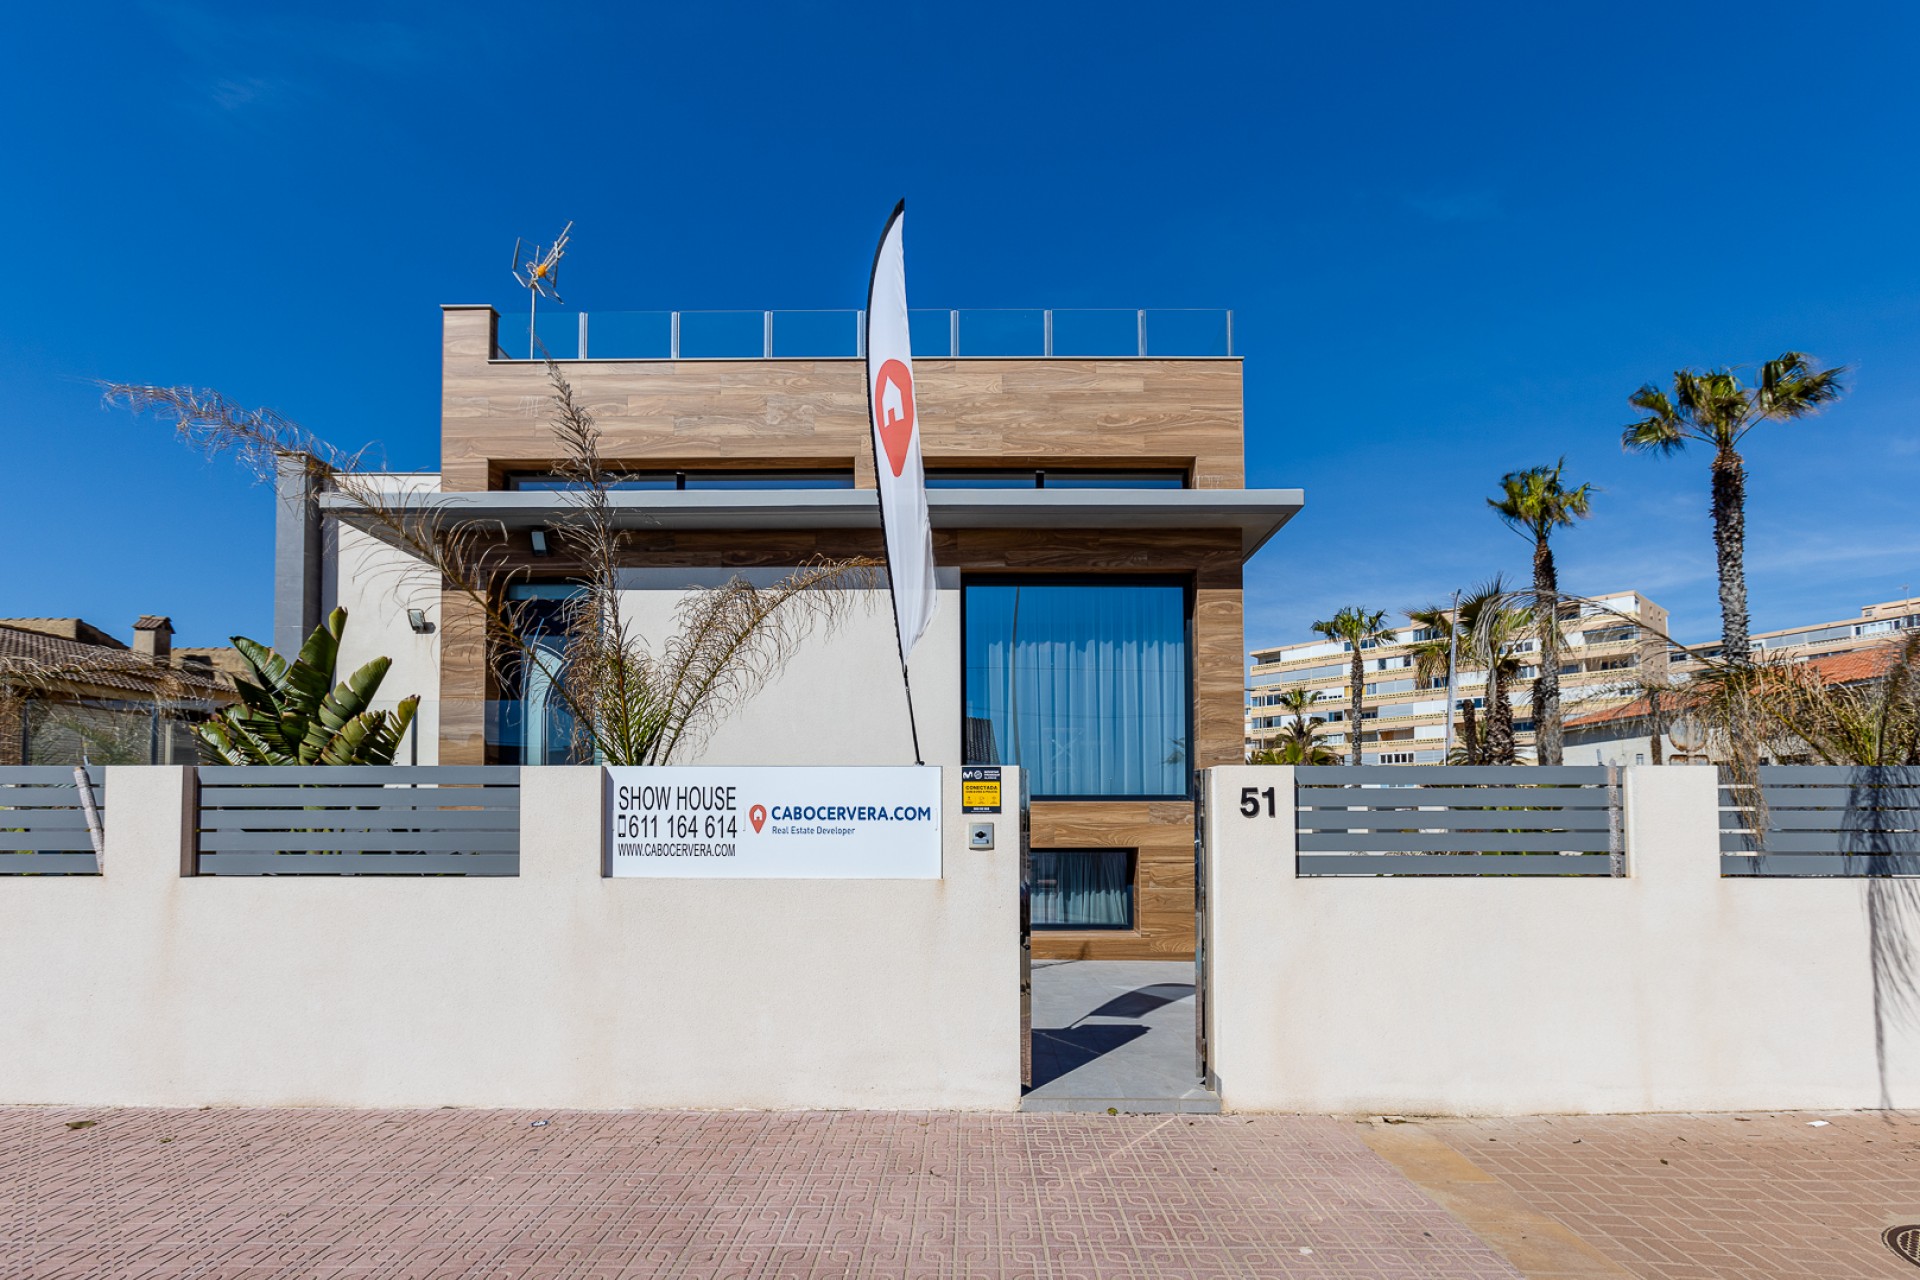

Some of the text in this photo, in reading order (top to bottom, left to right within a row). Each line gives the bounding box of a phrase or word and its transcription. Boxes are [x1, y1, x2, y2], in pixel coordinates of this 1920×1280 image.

[618, 785, 737, 811] SHOW HOUSE
[1240, 786, 1276, 819] 51
[771, 805, 931, 821] CABOCERVERA.COM
[628, 814, 737, 838] 611 164 614
[772, 826, 855, 837] Real Estate Developer
[618, 843, 736, 857] WWW.CABOCERVERA.COM
